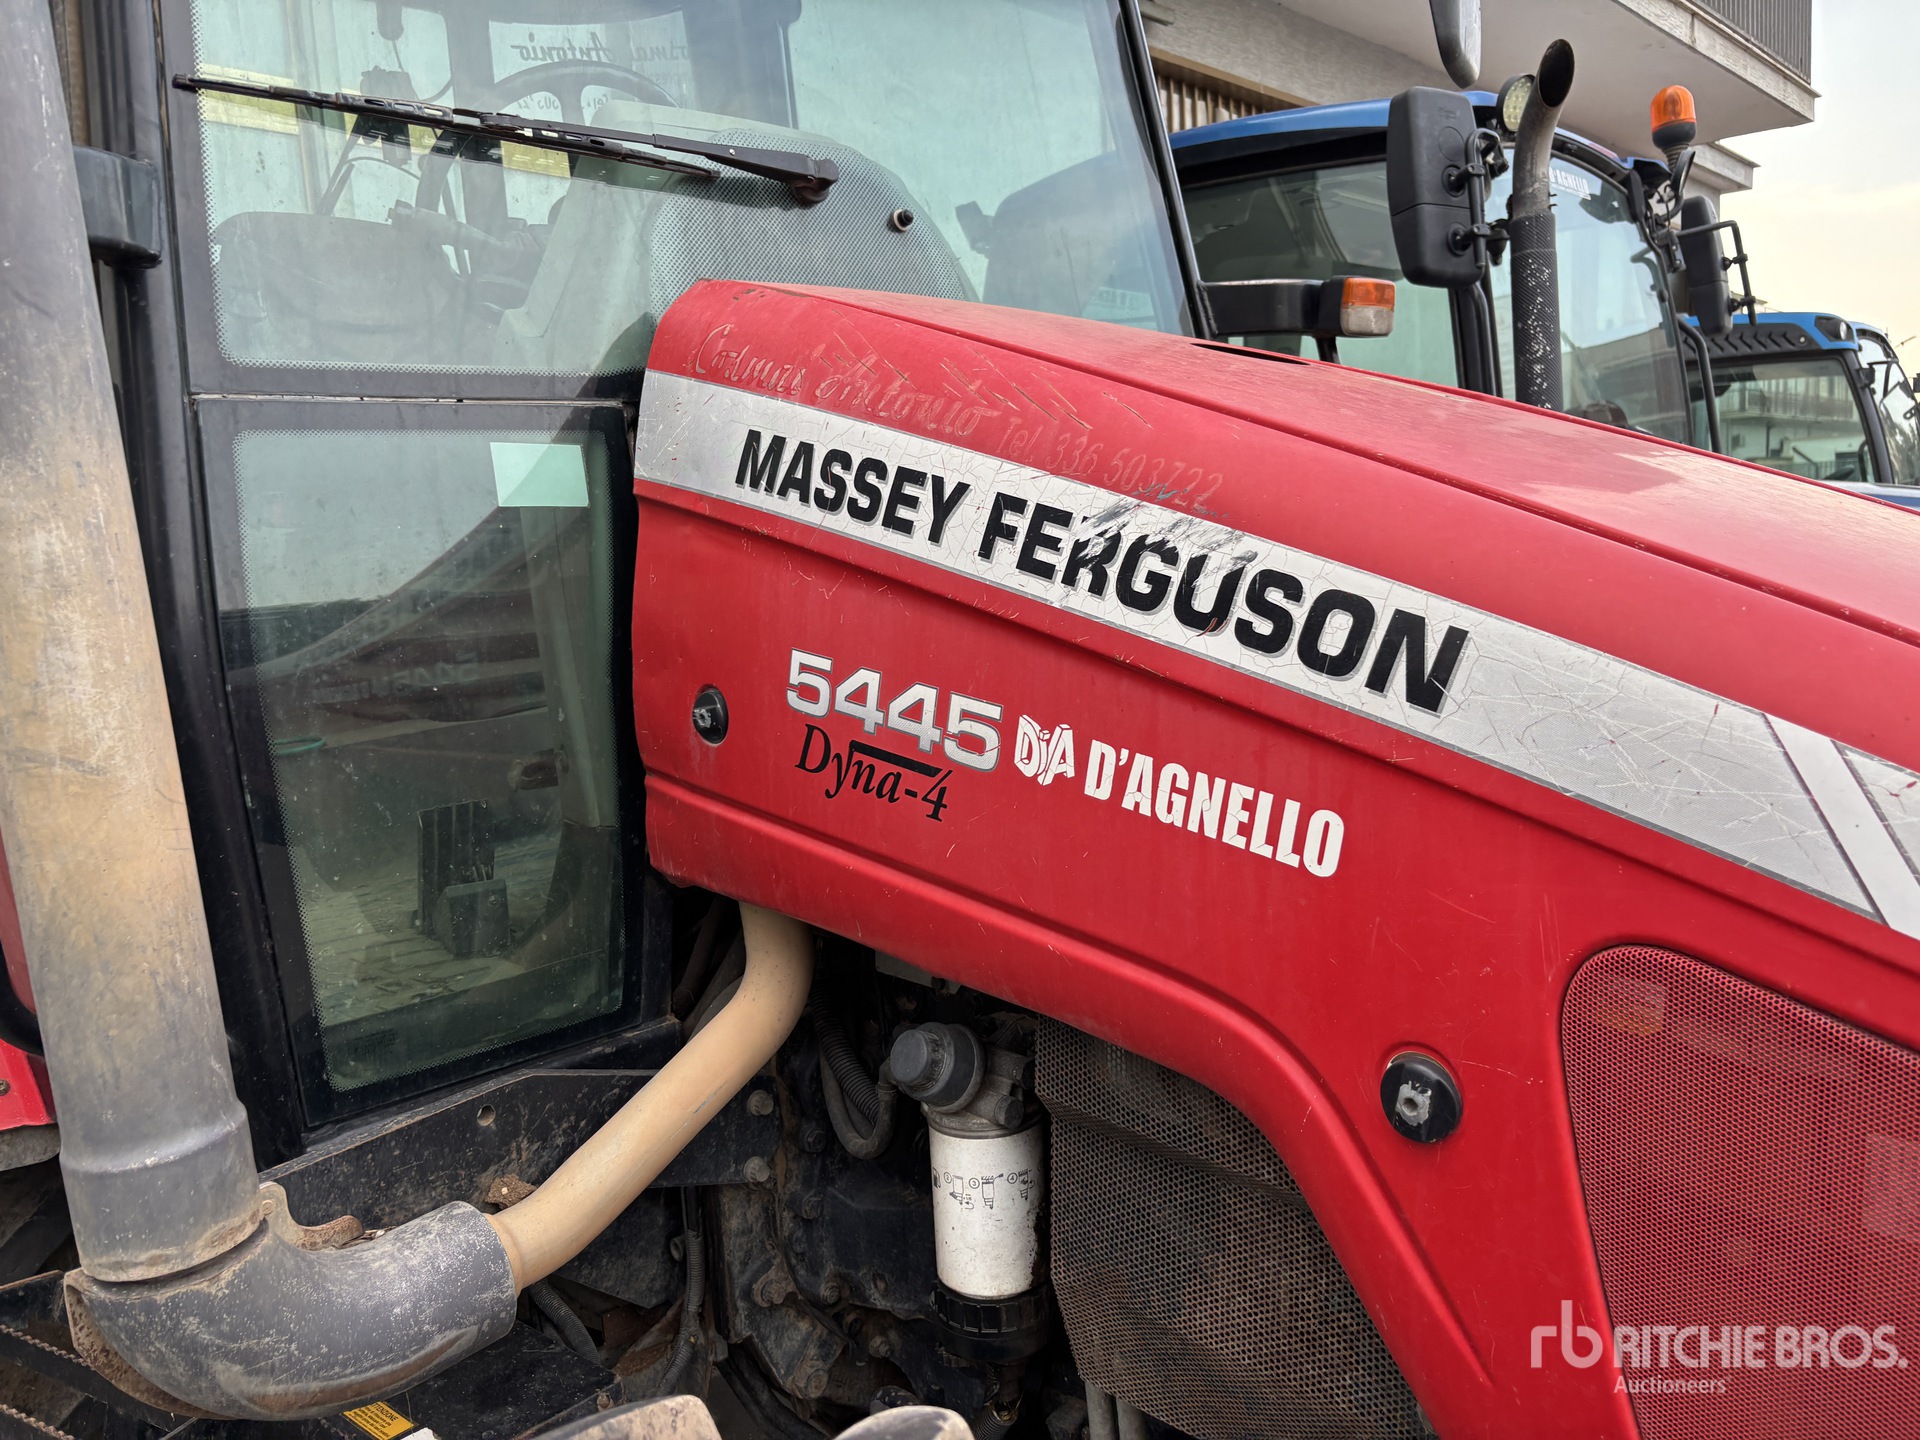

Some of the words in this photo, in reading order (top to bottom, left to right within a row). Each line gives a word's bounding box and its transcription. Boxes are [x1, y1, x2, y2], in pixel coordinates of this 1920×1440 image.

[1046, 432, 1104, 477] 336
[735, 429, 972, 547] MASSEY
[978, 491, 1469, 714] FERGUSON
[786, 647, 1004, 772] 5445
[795, 723, 953, 822] Dyna-4
[1084, 739, 1344, 877] D'AGNELLO
